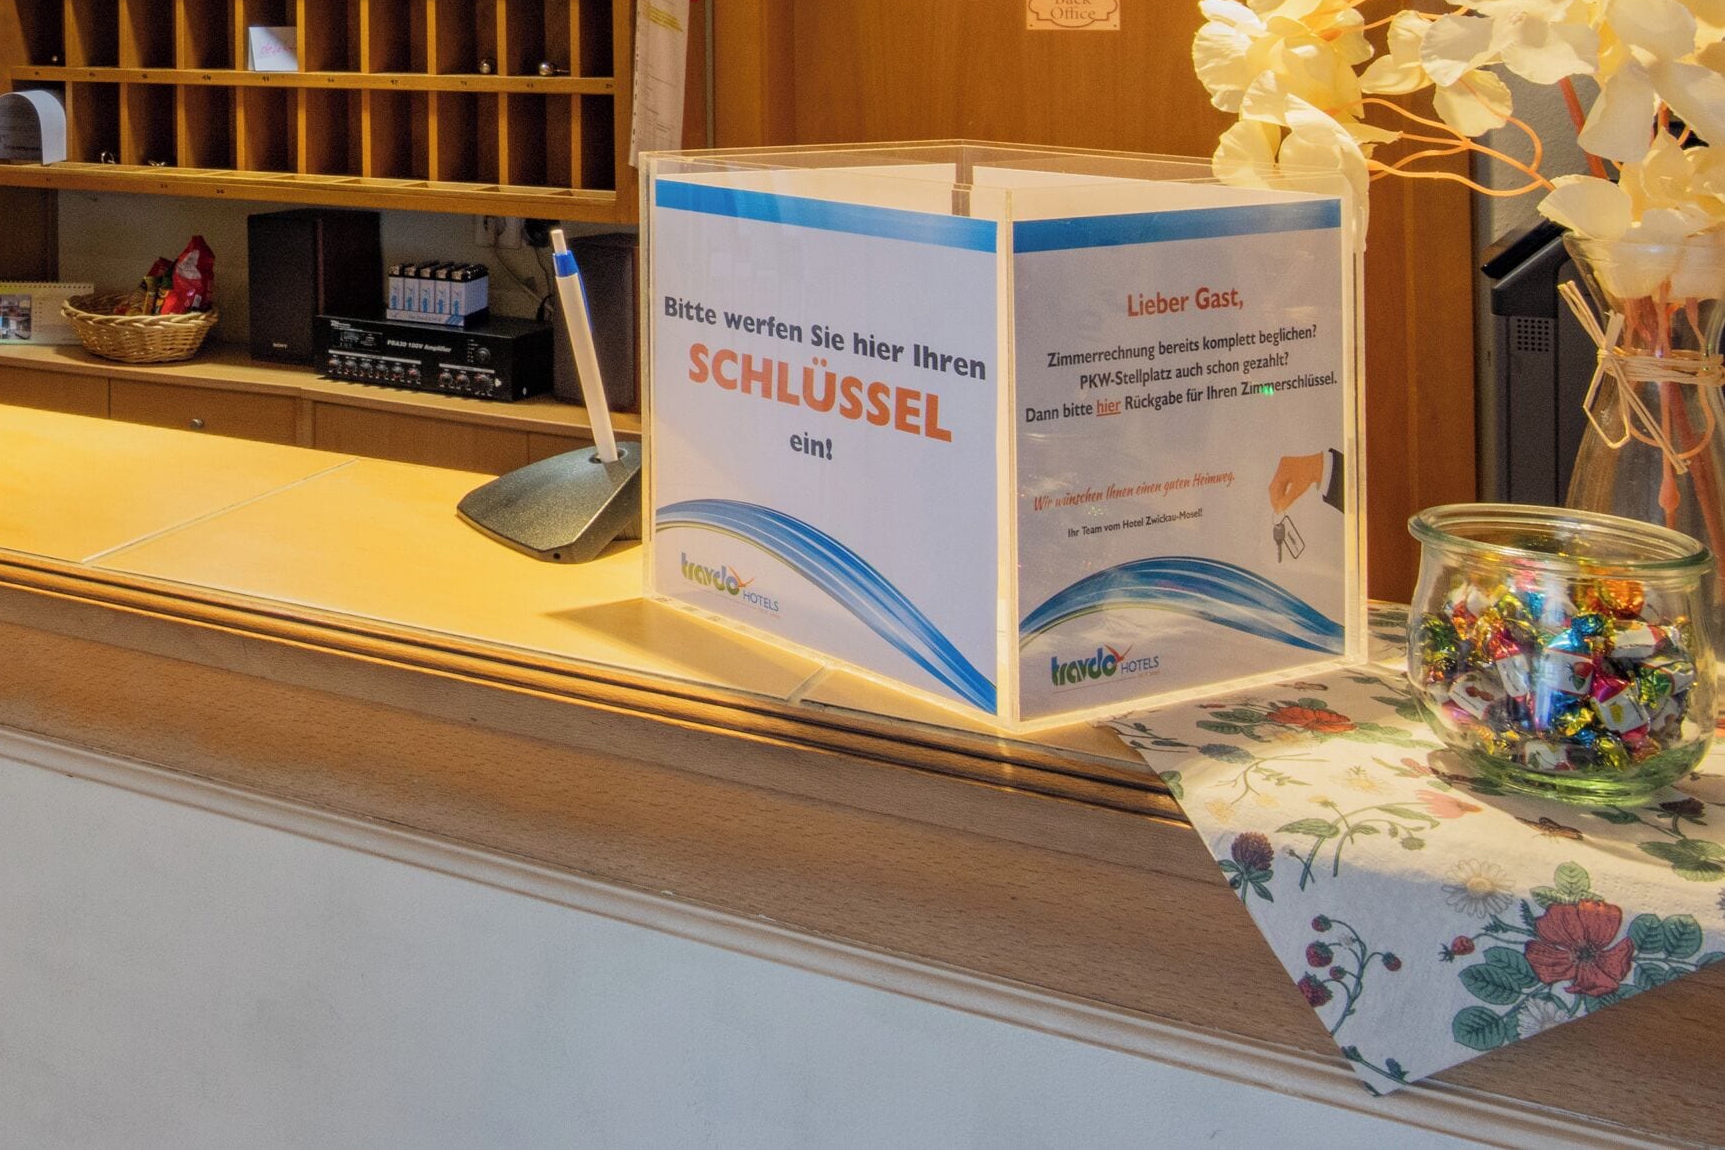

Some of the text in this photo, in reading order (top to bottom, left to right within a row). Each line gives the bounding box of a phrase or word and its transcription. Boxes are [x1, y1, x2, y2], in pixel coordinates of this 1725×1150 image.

[1050, 6, 1096, 20] Office
[1127, 287, 1244, 317] Lieber Gast,
[664, 296, 987, 381] Bitte werfen Sie hier Ihren
[1047, 324, 1317, 368] Zimmerrechnung bereits komplett beglichen?
[1079, 351, 1289, 390] PKW-Stellplatz auch schon gezahlt?
[688, 343, 953, 443] SCHLÜSSEL
[1025, 372, 1338, 423] Dann bitte hier Rückgabe für Ihren Zimmerschlüssel.
[789, 432, 833, 460] ein!
[1033, 471, 1236, 511] Wir wünschen Ihnen einen guten Heimweg.
[1068, 508, 1203, 538] Ihr Team vom Hotel Zwickau-Mosel!
[680, 551, 780, 612] travdo HOTELS
[1051, 647, 1160, 686] travdo HOTELS
